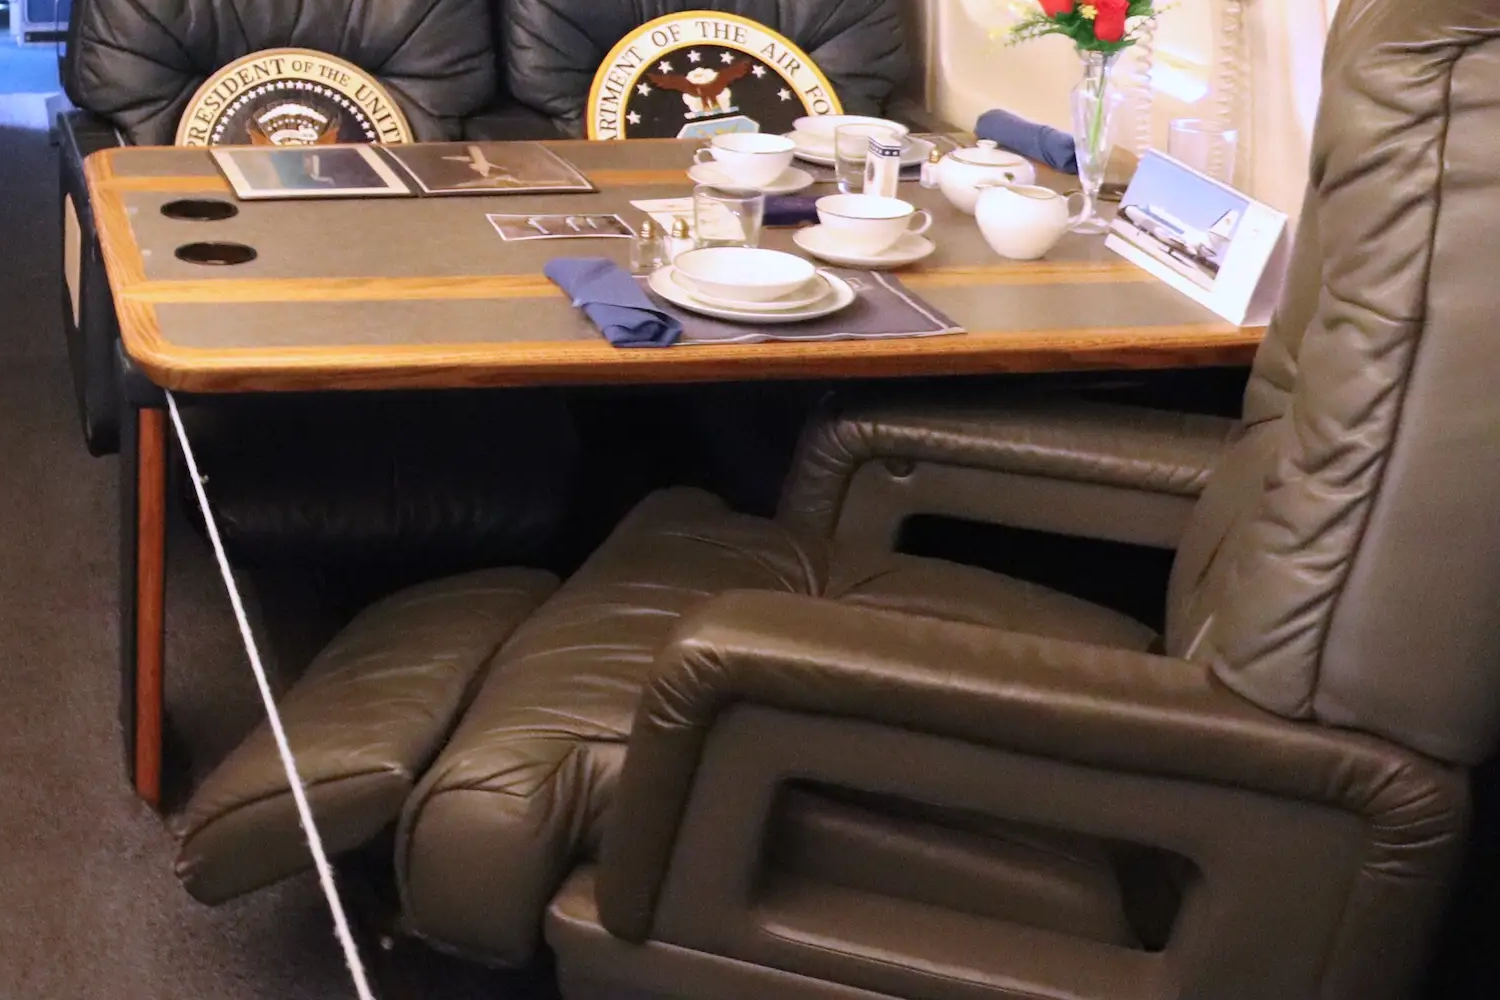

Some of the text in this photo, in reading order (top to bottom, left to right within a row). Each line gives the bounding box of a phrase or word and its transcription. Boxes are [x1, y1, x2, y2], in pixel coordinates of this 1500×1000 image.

[291, 60, 315, 73] OF
[318, 64, 351, 87] THE
[355, 83, 403, 144] UNIT
[600, 45, 645, 140] RTMENT
[651, 23, 682, 48] OF
[695, 20, 748, 44] THE
[760, 42, 802, 78] AIR
